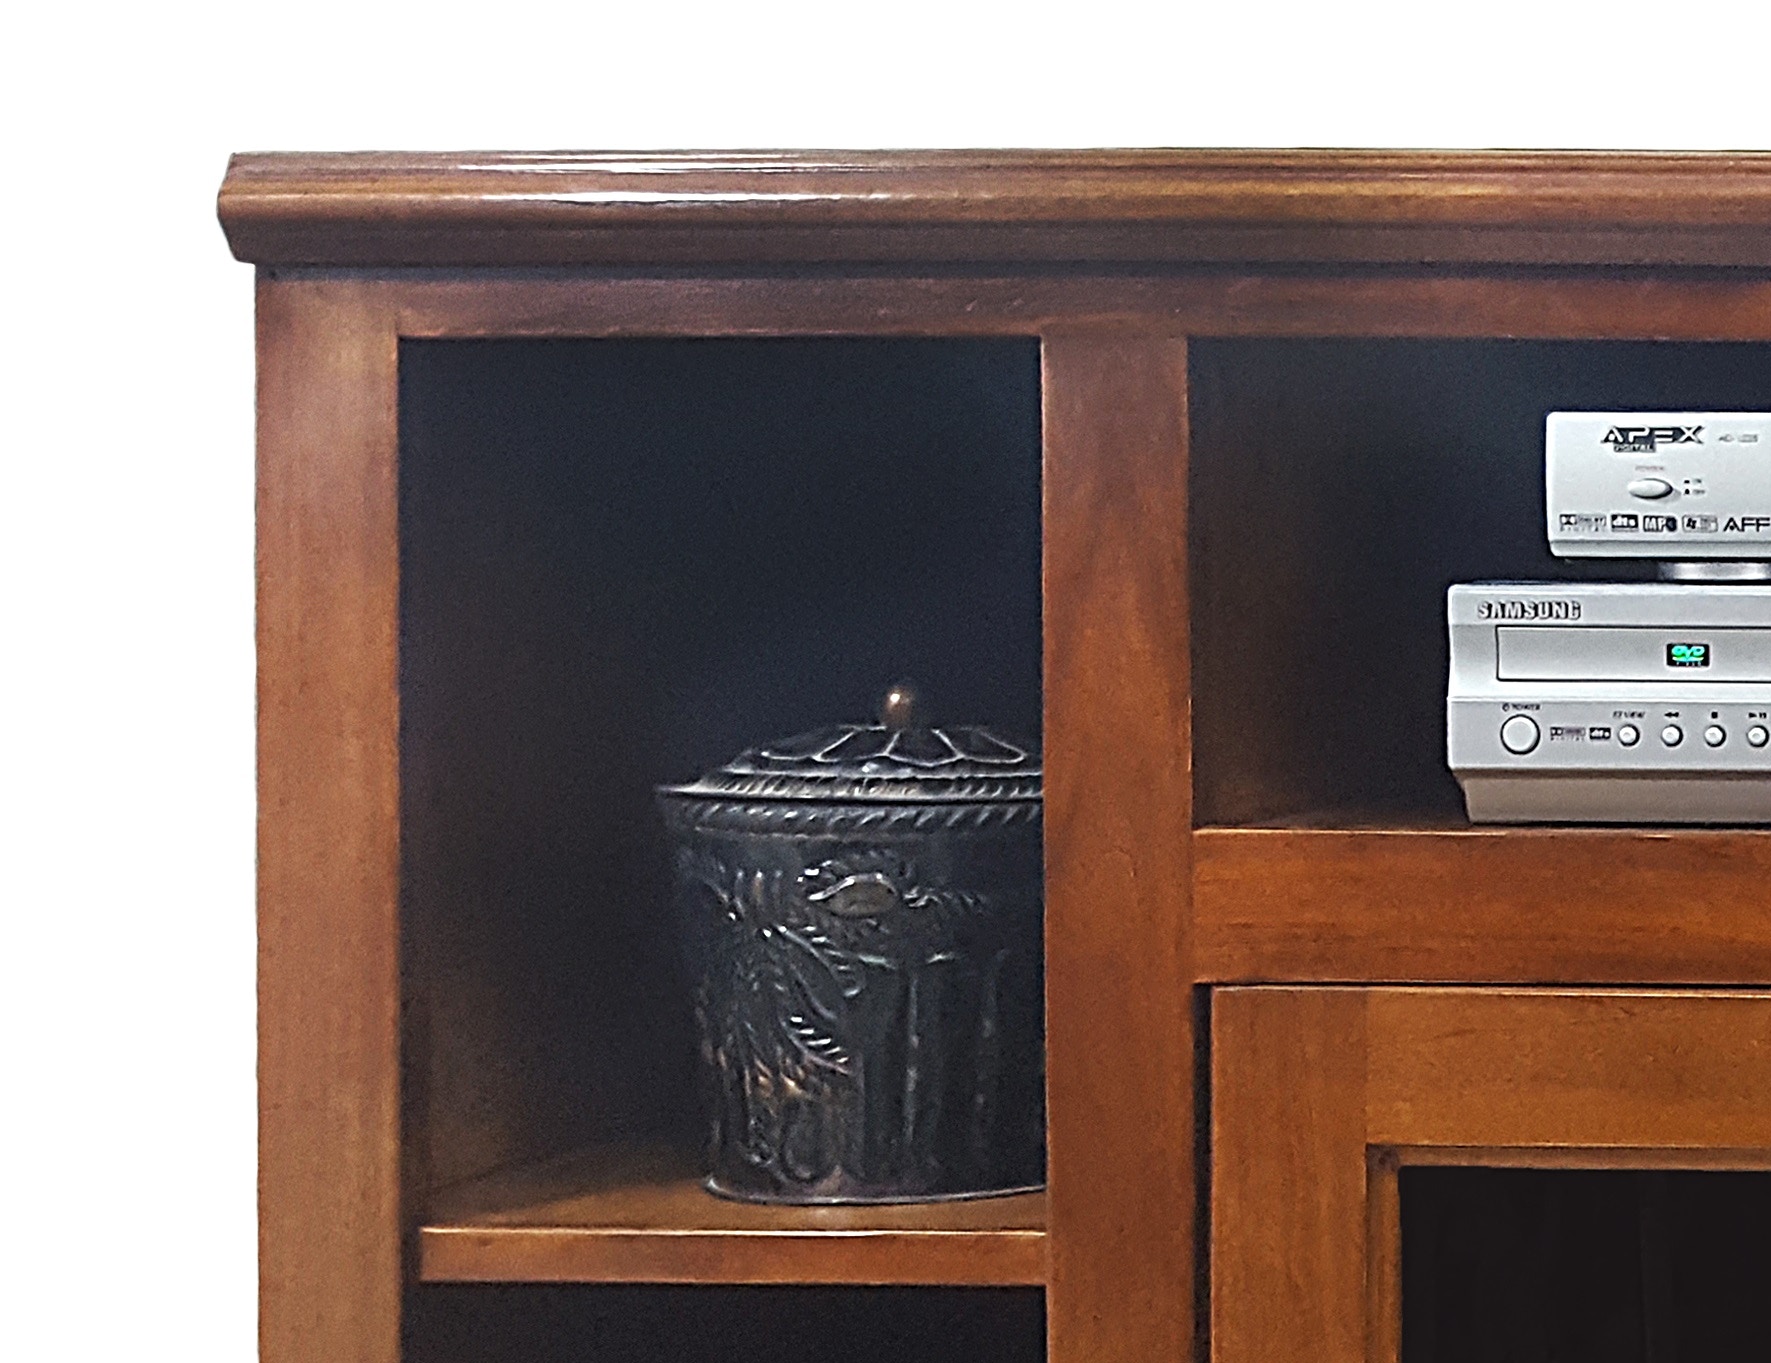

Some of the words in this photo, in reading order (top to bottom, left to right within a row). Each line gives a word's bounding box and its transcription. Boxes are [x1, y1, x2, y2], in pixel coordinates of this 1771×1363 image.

[1601, 425, 1704, 444] APEX
[1723, 516, 1771, 532] AFF
[1478, 600, 1582, 620] SAMSUNG
